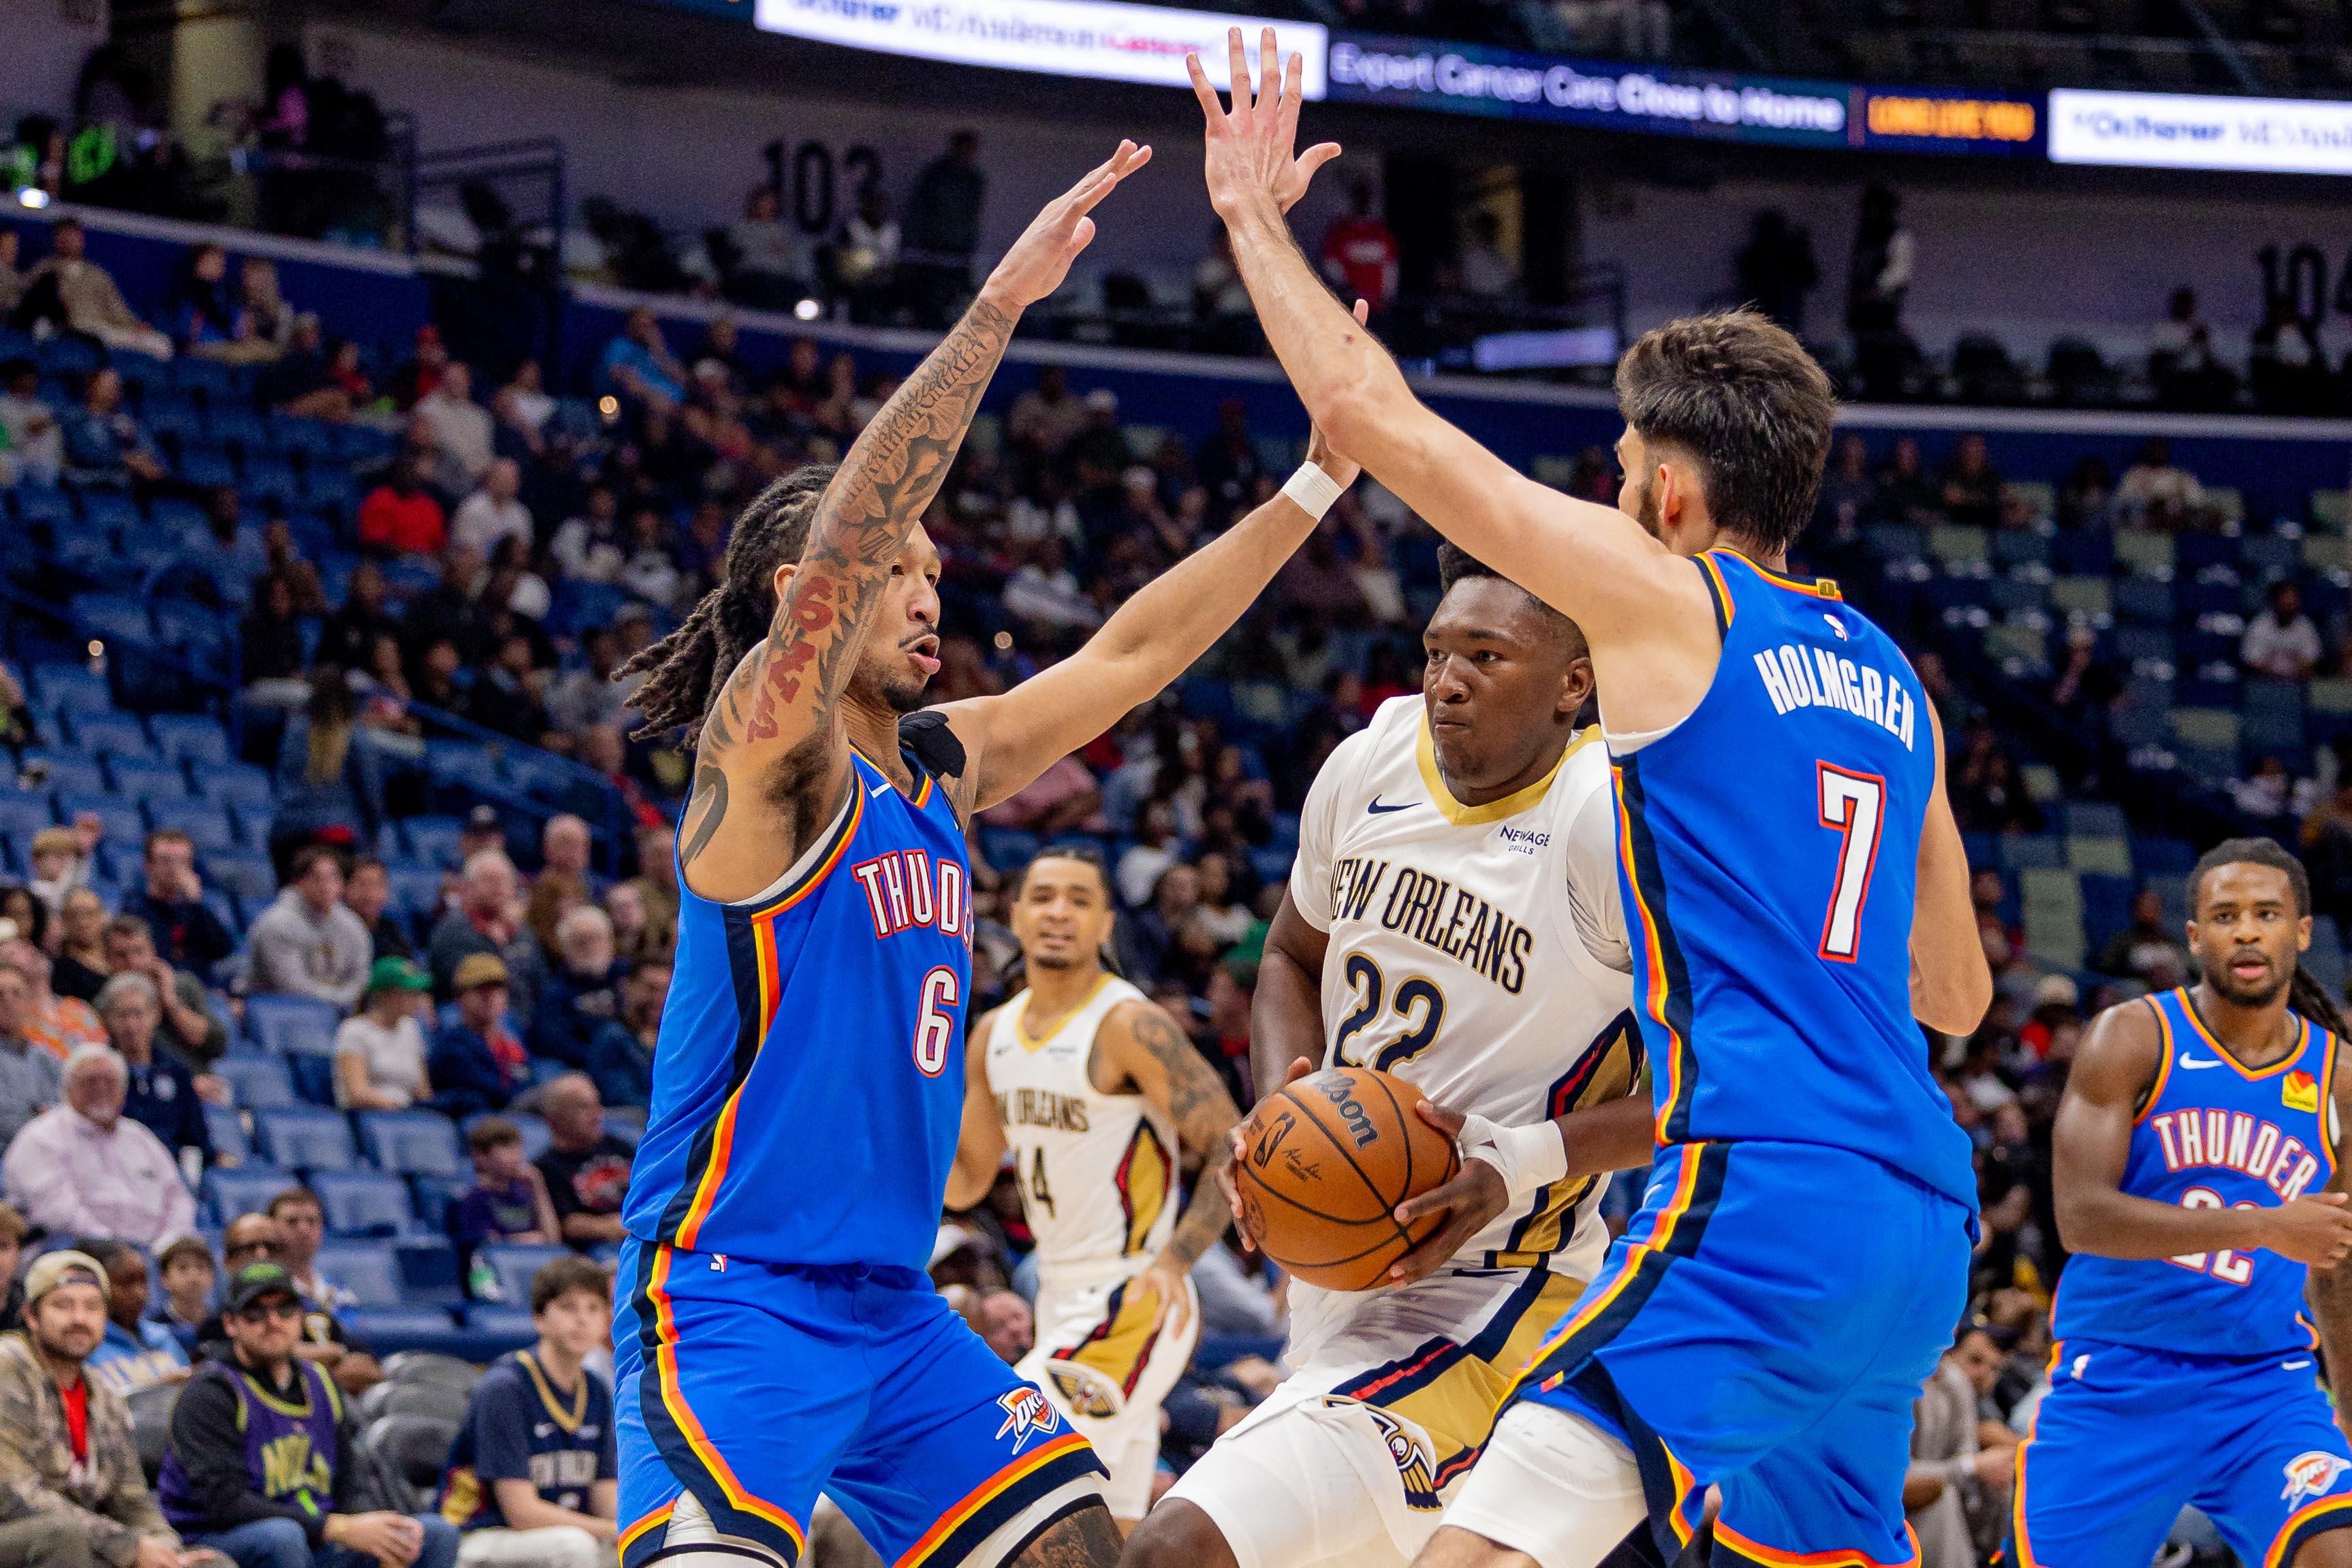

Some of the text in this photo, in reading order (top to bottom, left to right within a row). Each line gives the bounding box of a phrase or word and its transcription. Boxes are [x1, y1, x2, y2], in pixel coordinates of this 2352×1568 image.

[1753, 644, 1915, 753] HOLMGREN
[1816, 758, 1886, 965] 7
[1380, 866, 1534, 997] ORLEANS
[913, 965, 960, 1079] 6
[1331, 950, 1447, 1076] 22
[2151, 1108, 2319, 1203] THUNDER
[1015, 1392, 1045, 1434] OKC
